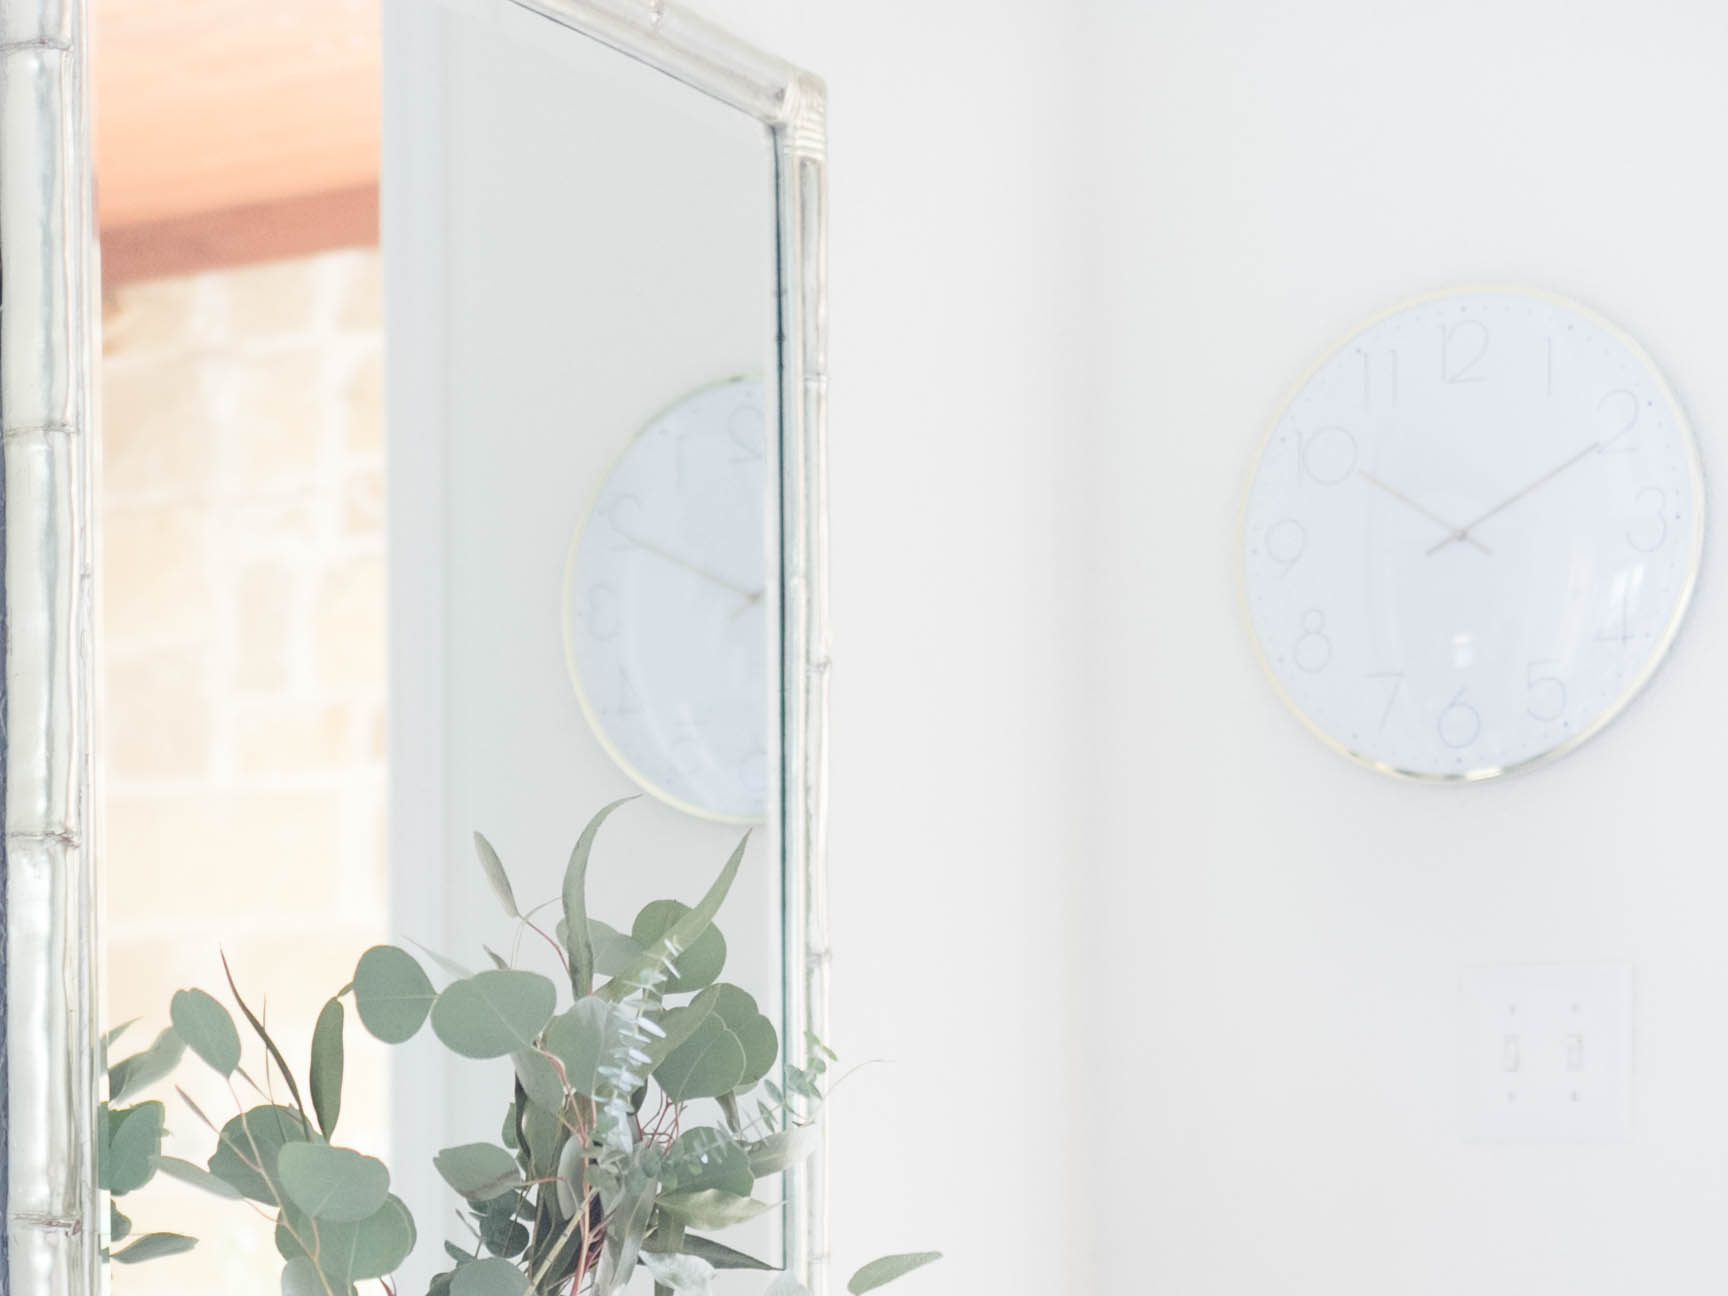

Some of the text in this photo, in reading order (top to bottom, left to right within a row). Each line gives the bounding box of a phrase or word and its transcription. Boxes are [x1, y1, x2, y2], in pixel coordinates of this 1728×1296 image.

[1361, 347, 1399, 415] 11
[1437, 318, 1490, 386] 12
[1594, 387, 1641, 455] 2
[1296, 425, 1360, 488] 10
[1265, 518, 1306, 579] 9
[1626, 486, 1668, 553] 3
[1292, 606, 1333, 674] 8
[1593, 588, 1636, 647] 4
[1364, 671, 1405, 734] 7
[1438, 685, 1481, 748] 6
[1525, 657, 1569, 723] 5
